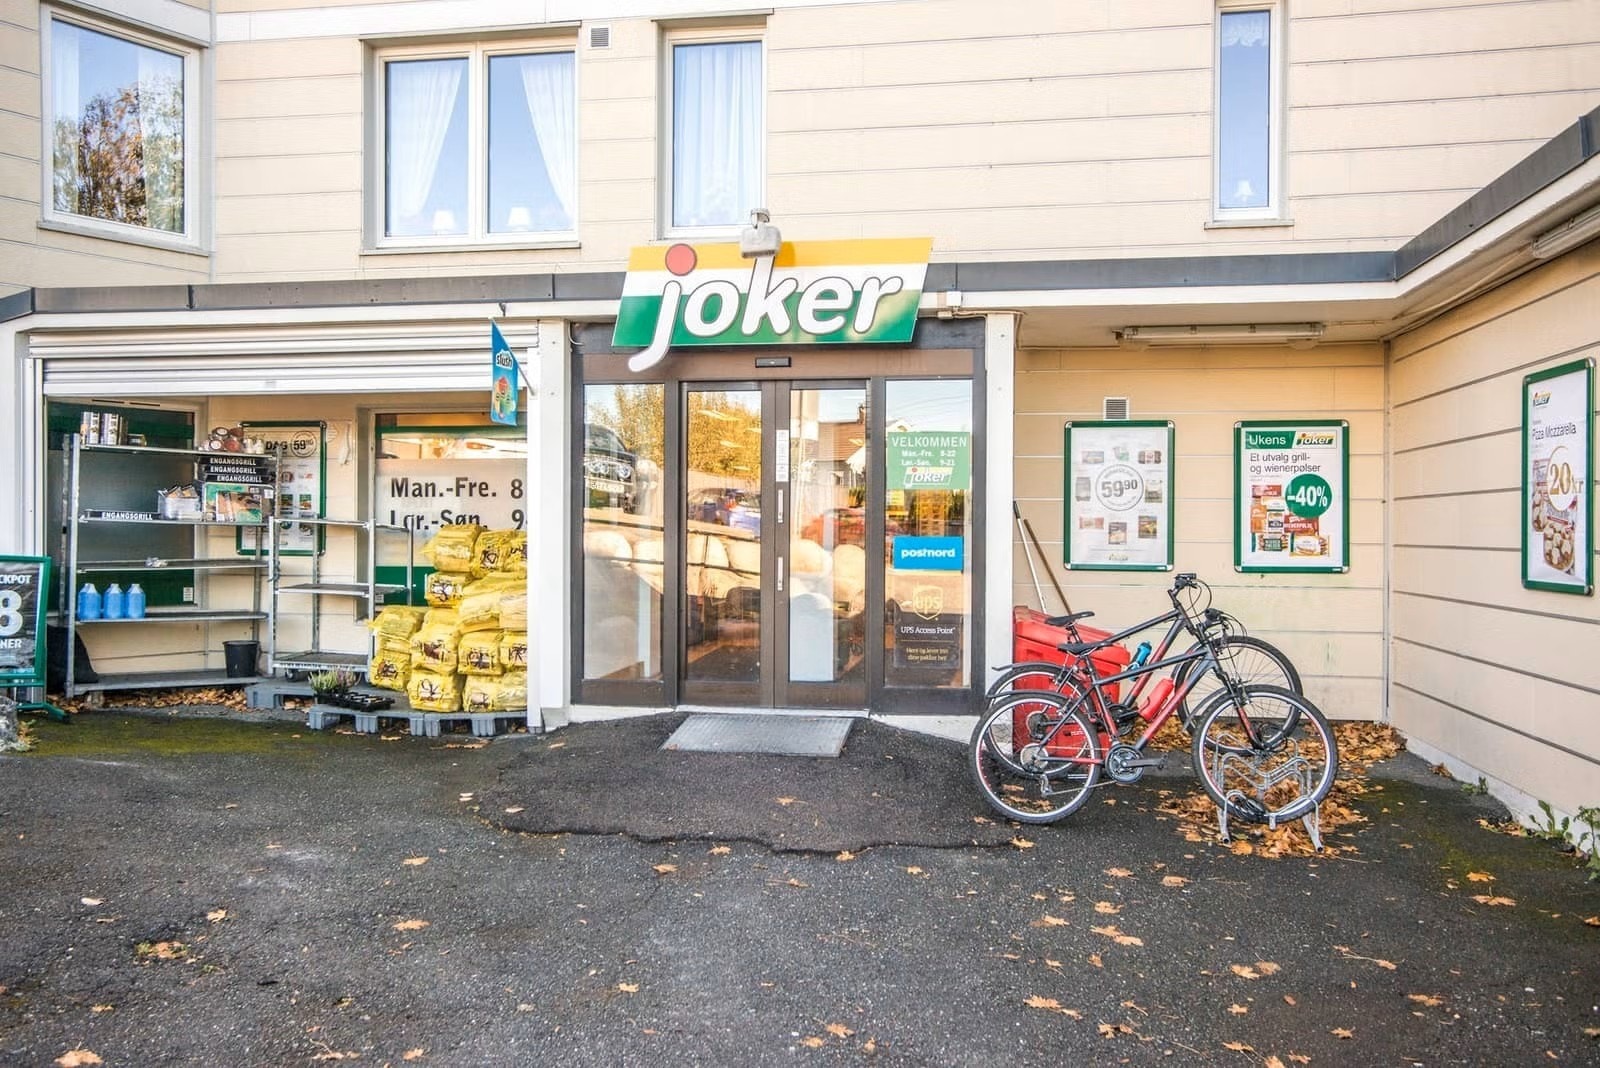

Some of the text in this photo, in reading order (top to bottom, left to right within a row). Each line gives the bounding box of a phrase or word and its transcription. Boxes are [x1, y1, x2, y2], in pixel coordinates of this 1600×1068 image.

[628, 243, 904, 373] joker
[496, 353, 513, 368] slush
[891, 436, 967, 448] VELKOMMEN
[1249, 433, 1334, 446] Ukens joker
[210, 457, 257, 466] ENGANGSGRILL
[1250, 453, 1311, 463] Et utvalg grill-
[210, 466, 257, 474] ENGANGSGRILL
[1249, 464, 1321, 474] og wienerpølser
[217, 475, 262, 483] ENGANGSGRILL
[904, 467, 950, 488] joker
[1550, 462, 1571, 495] 20
[391, 477, 523, 499] Man.-Fre. 8
[1287, 485, 1328, 507] -40%
[101, 511, 153, 520] ENGANGSGRILL
[512, 509, 527, 530] 9
[901, 548, 956, 559] postnord
[0, 590, 23, 636] 8
[901, 626, 914, 634] UPS
[914, 626, 936, 634] Access
